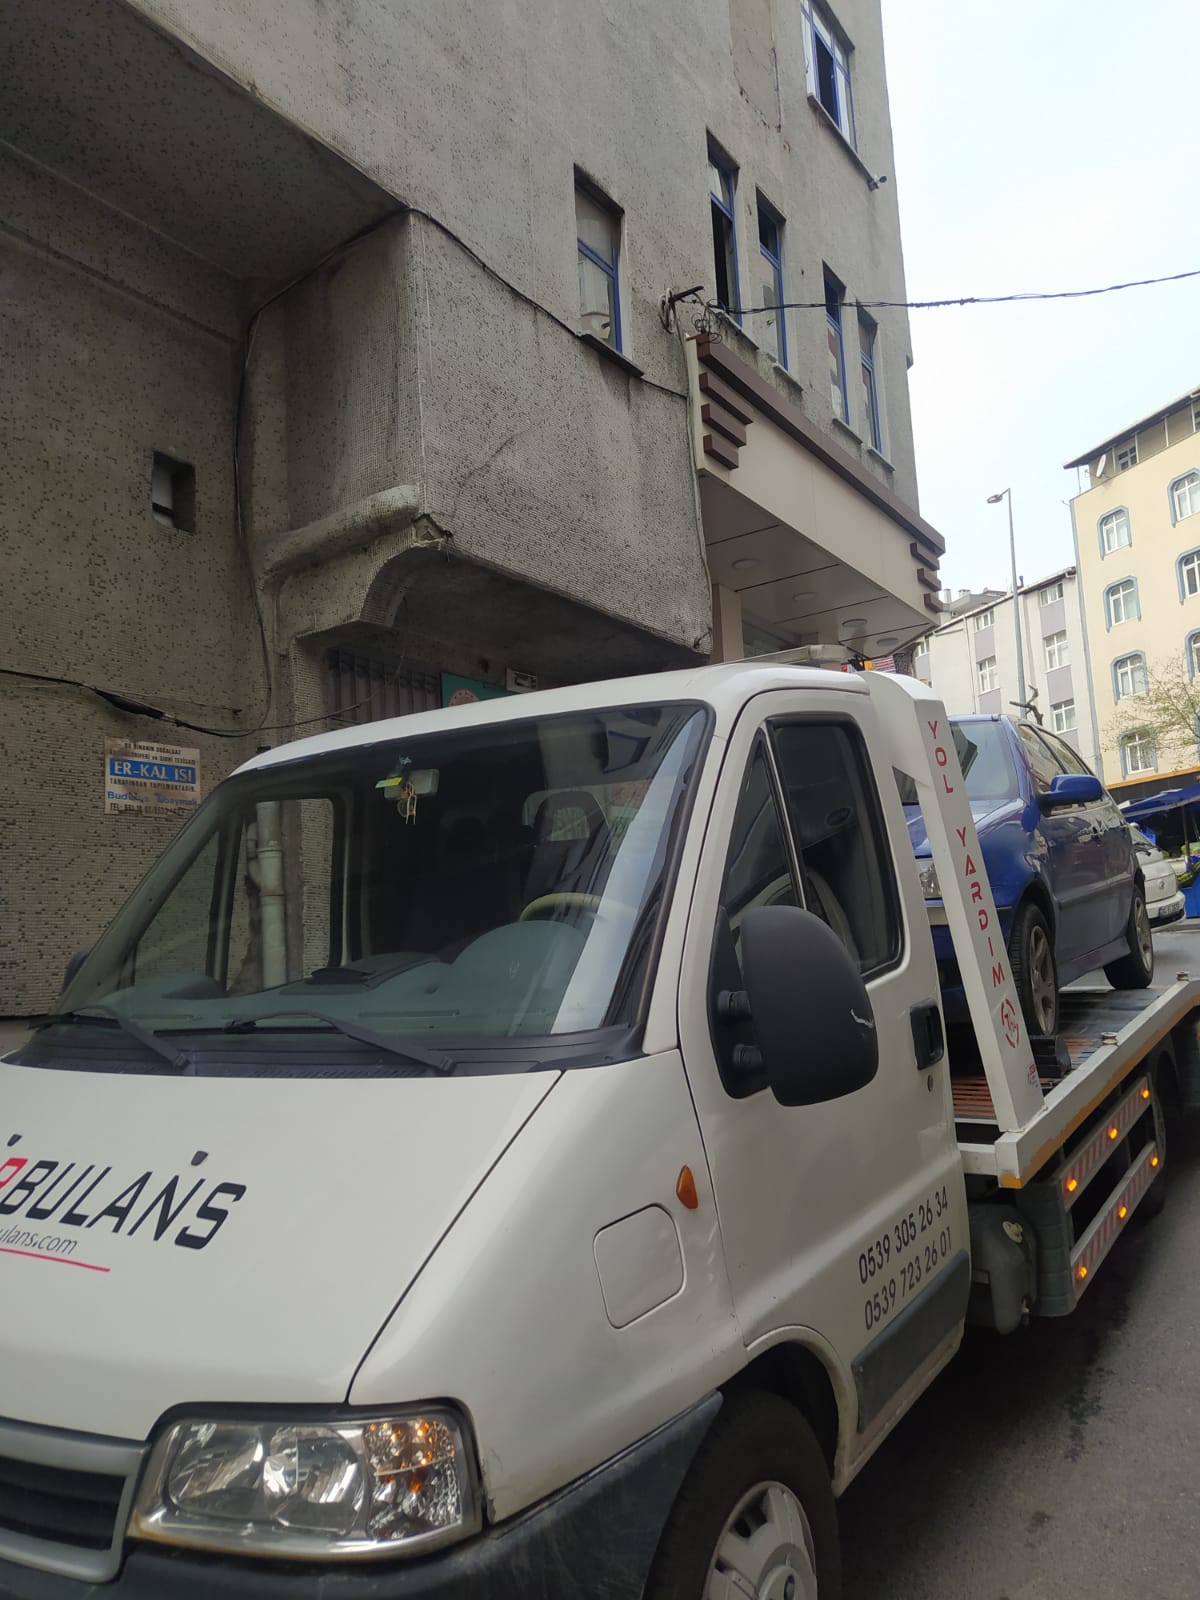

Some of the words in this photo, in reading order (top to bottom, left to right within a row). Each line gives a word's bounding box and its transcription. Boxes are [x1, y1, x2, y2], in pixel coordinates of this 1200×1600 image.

[114, 760, 168, 780] ER-KAL
[927, 719, 954, 794] YOL
[955, 825, 1006, 988] YARDIM
[0, 1225, 78, 1255] ulans.com
[858, 1234, 890, 1284] 0539
[895, 1213, 916, 1253] 305
[918, 1198, 933, 1232] 26
[935, 1185, 948, 1217] 34
[865, 1278, 896, 1330] 0539
[900, 1255, 922, 1297] 723
[924, 1240, 938, 1274] 26
